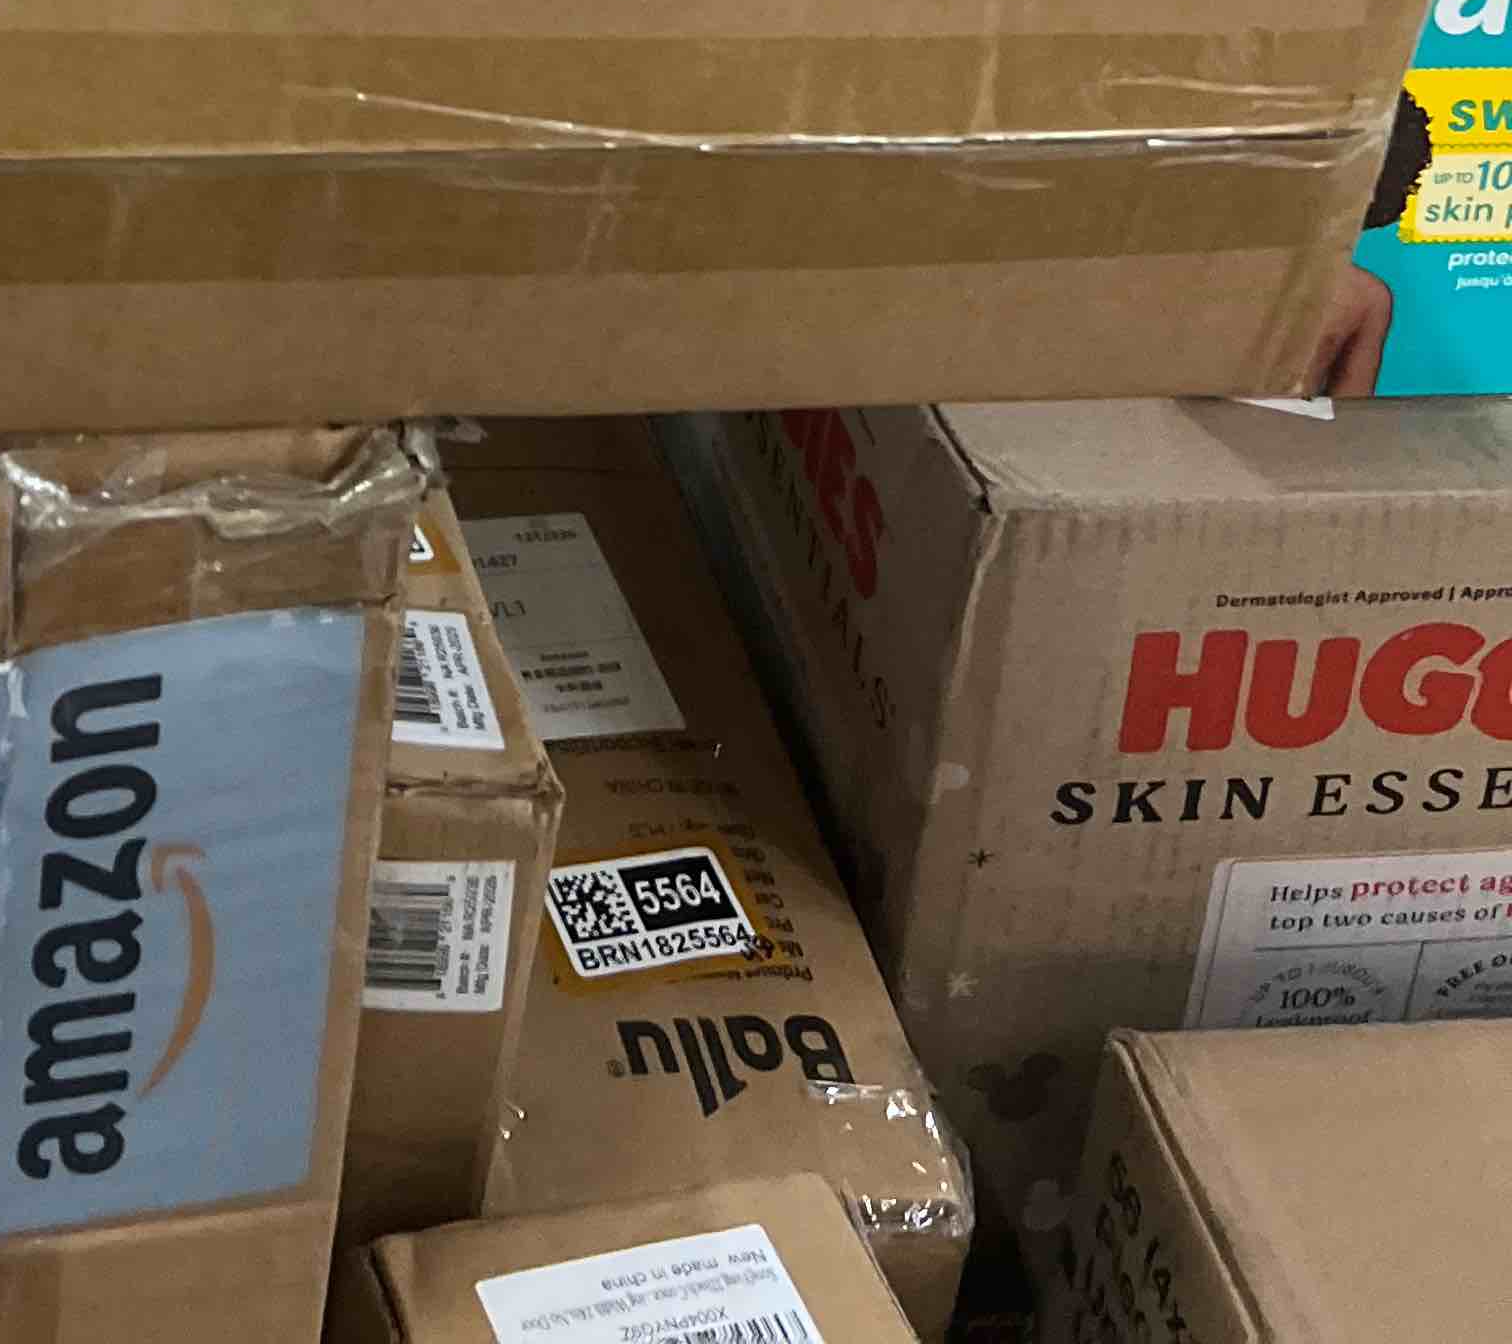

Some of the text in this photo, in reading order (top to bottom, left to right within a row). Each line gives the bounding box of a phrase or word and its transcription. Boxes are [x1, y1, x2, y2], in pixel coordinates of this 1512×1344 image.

[1434, 172, 1453, 185] UP
[1456, 172, 1474, 184] TO
[1424, 196, 1494, 224] skin
[1215, 591, 1349, 609] Dermatologist
[1354, 586, 1443, 606] Approved
[1050, 776, 1274, 826] SKIN
[635, 872, 722, 915] 5564
[1269, 883, 1344, 905] Helps
[1350, 874, 1470, 902] protect
[17, 672, 163, 1180] amazon
[1270, 904, 1503, 932] top two causes of
[577, 921, 754, 971] BRN1825564
[1280, 986, 1356, 1010] 100%
[1436, 959, 1484, 998] FREE
[617, 1015, 855, 1118] Ballu
[601, 1249, 768, 1291] New made in china
